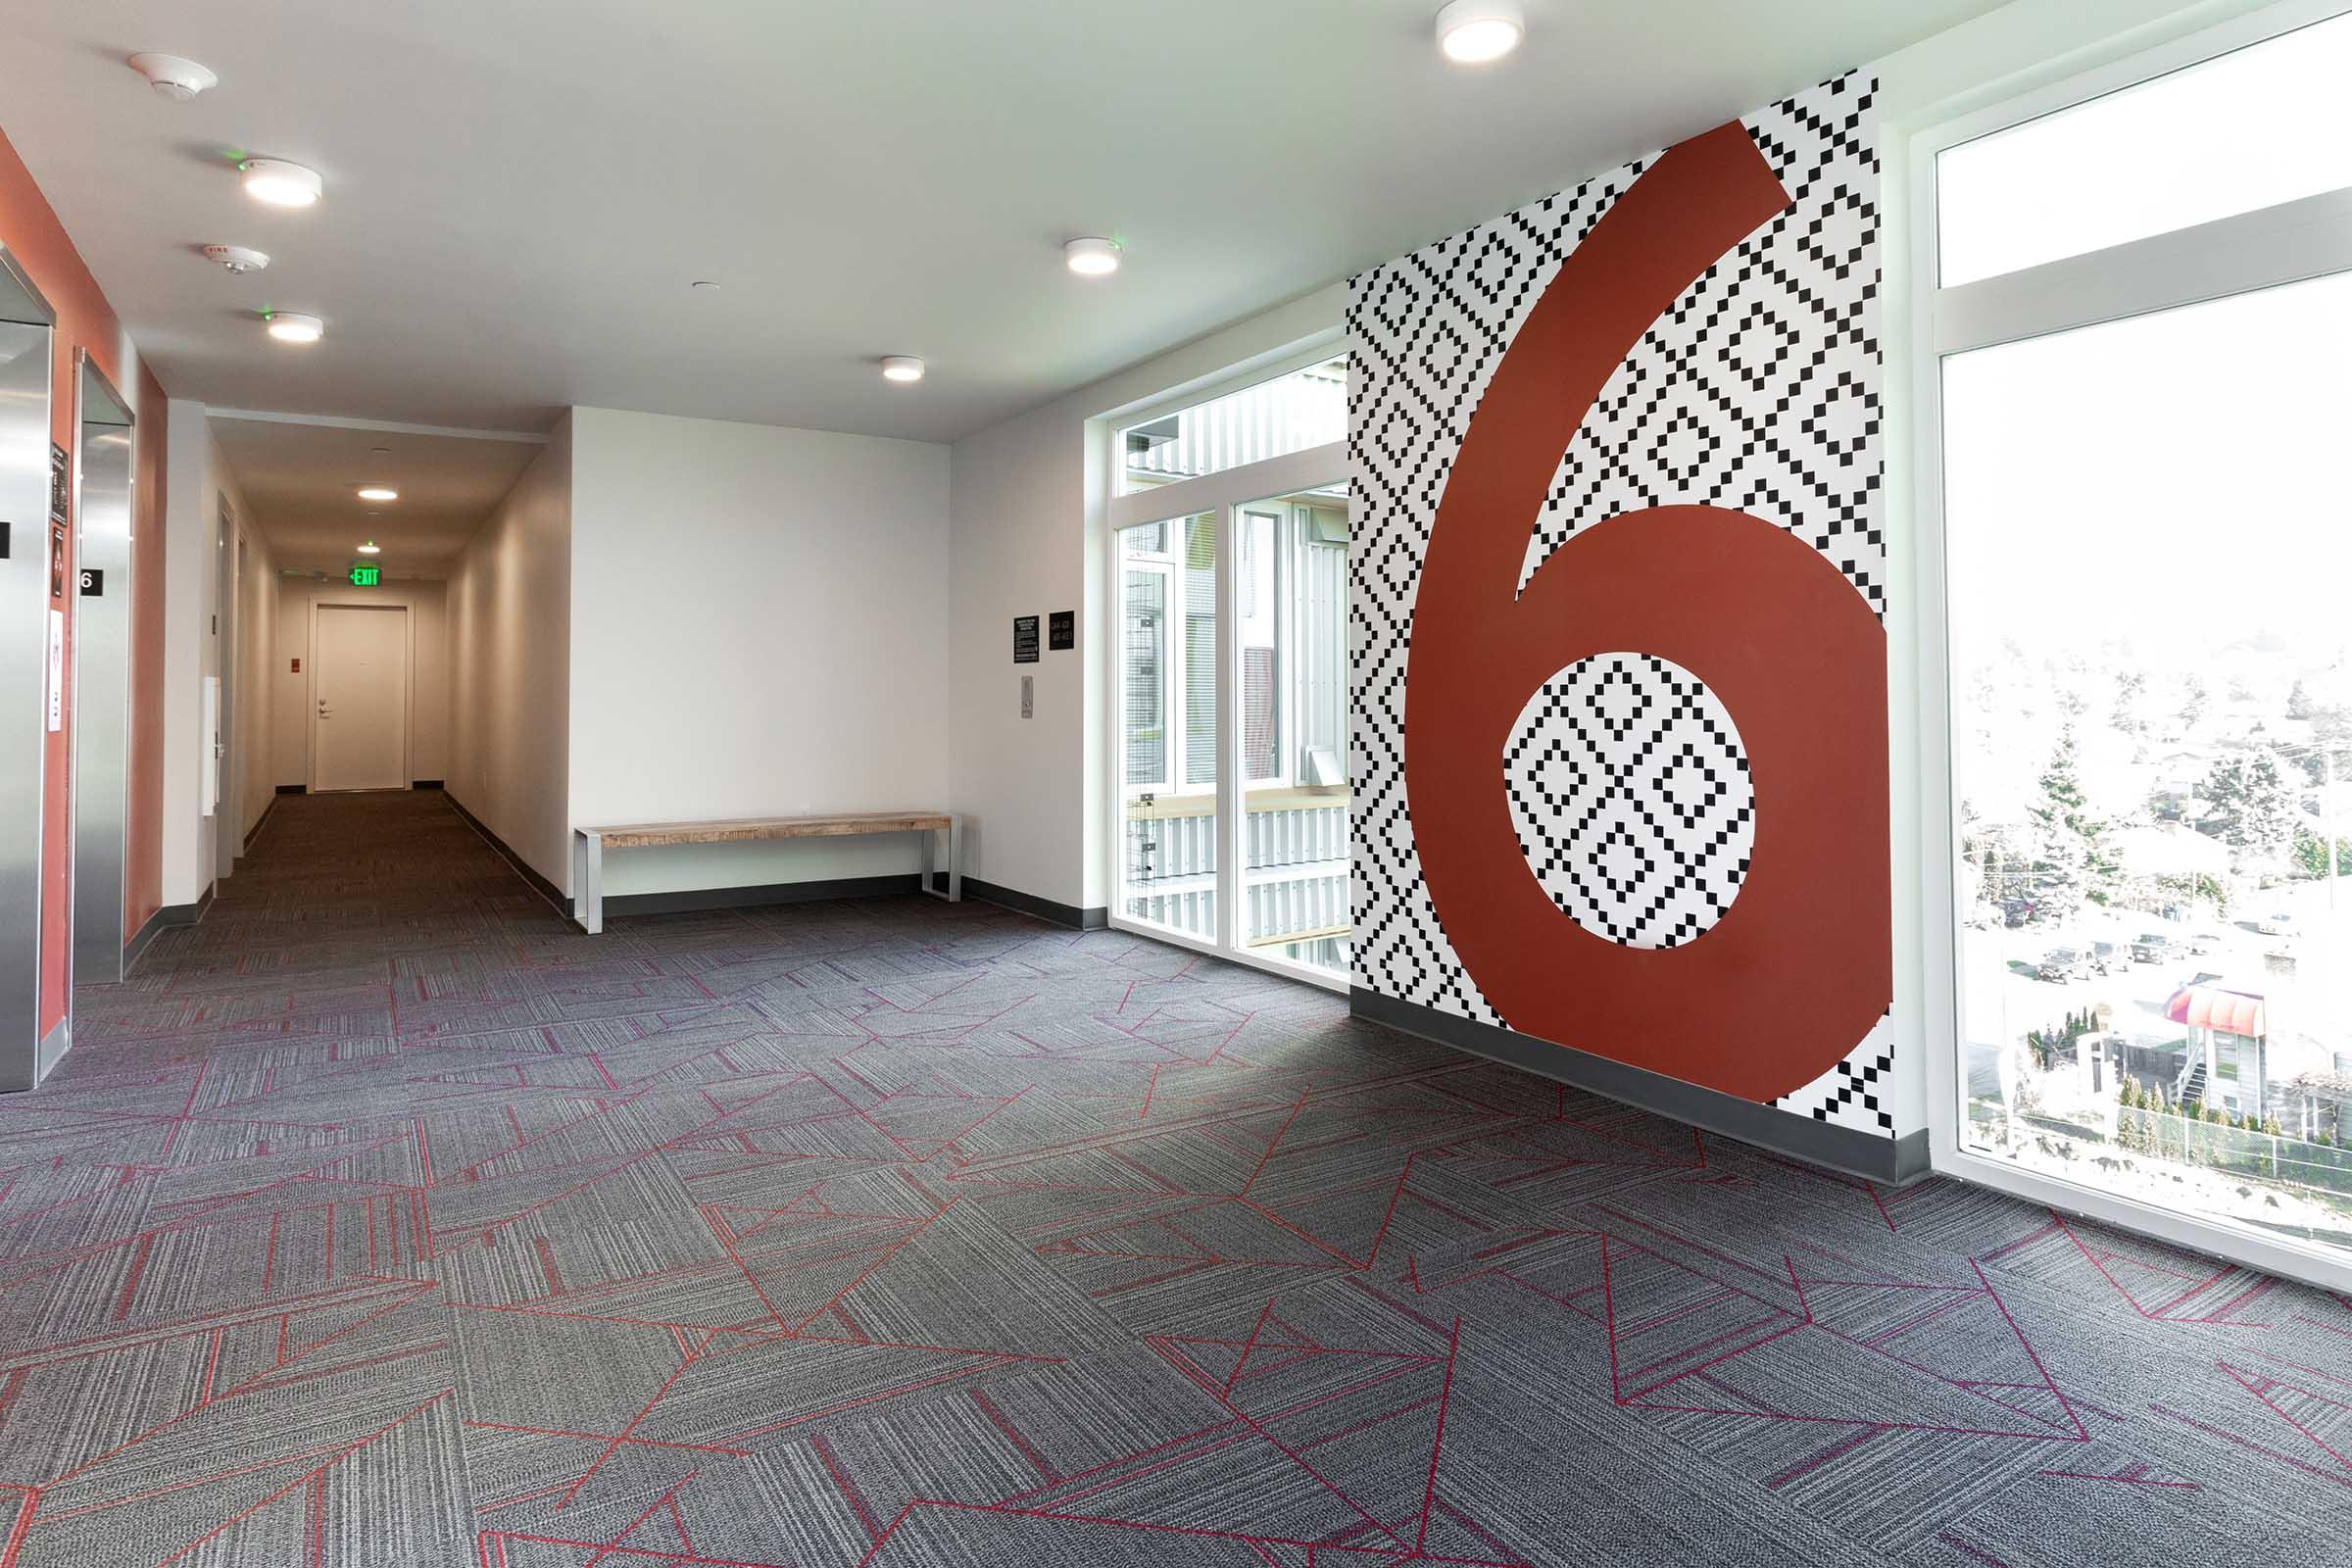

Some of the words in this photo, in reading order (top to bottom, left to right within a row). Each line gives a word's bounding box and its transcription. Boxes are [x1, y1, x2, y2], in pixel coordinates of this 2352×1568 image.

[80, 571, 93, 588] 6
[354, 568, 378, 585] EXIT
[1404, 119, 1892, 1103] 6
